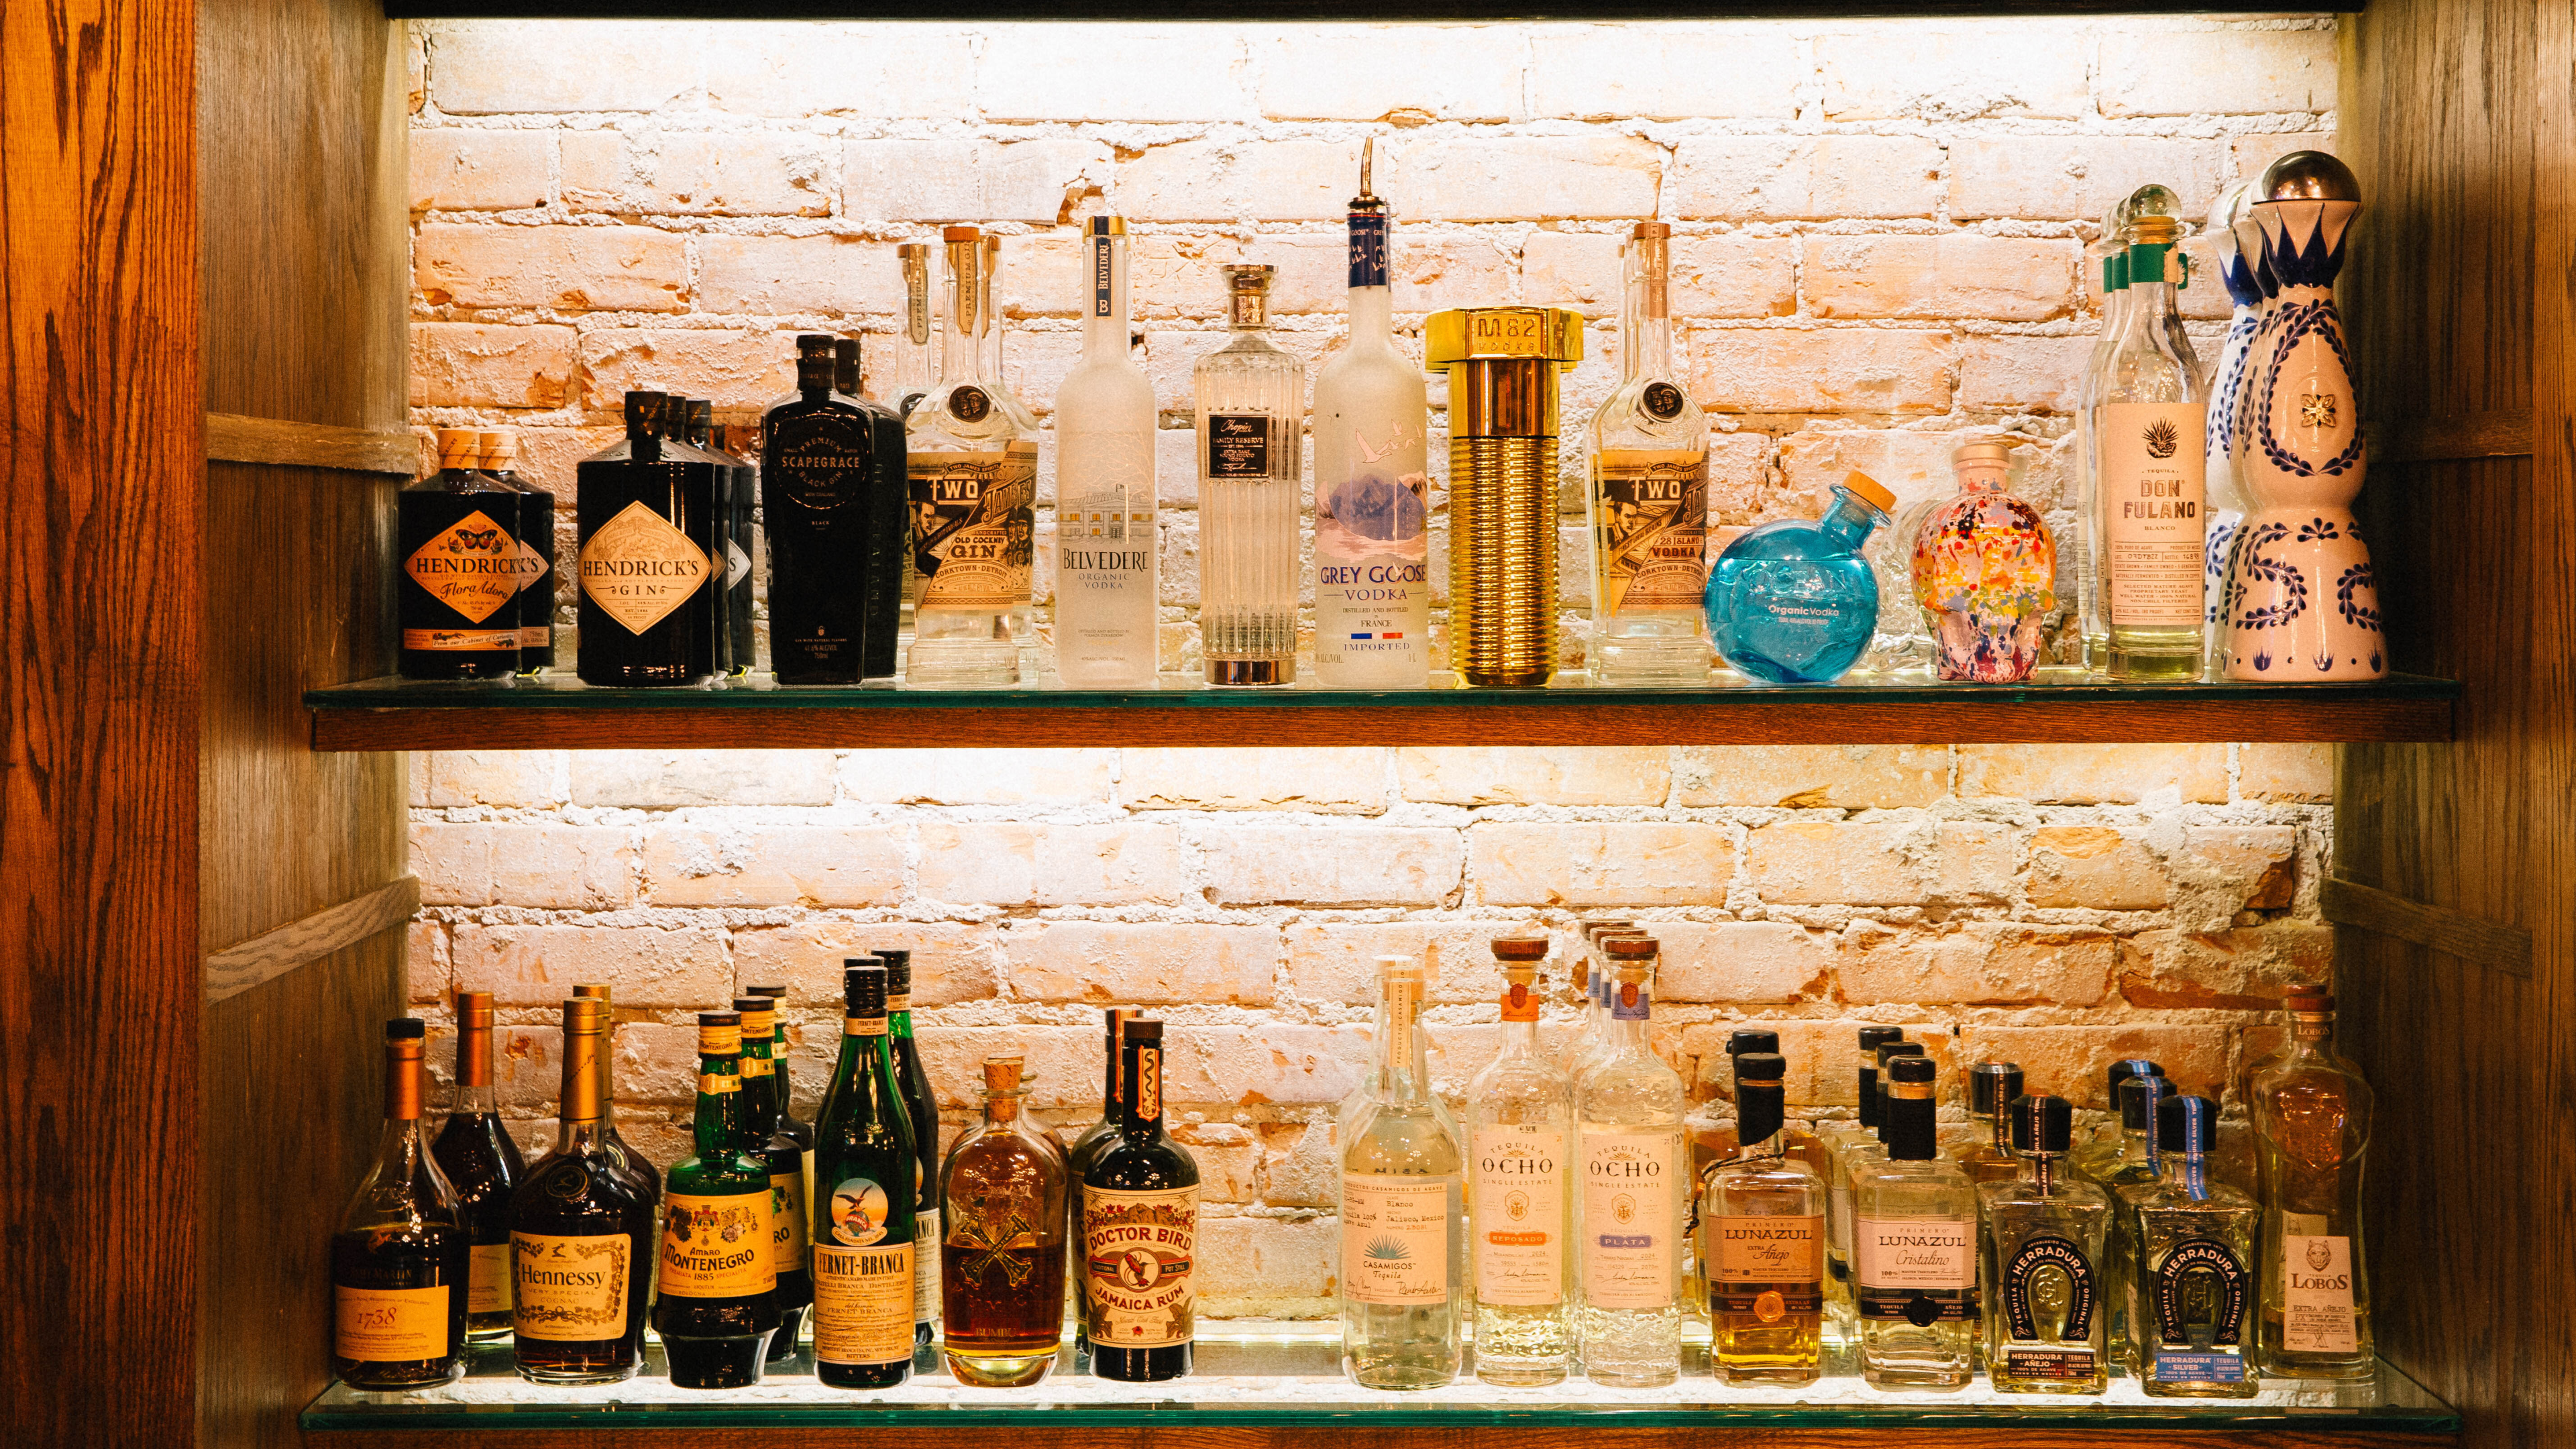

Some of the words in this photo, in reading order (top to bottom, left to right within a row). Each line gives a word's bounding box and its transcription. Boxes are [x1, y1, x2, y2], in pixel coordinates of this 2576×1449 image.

[1098, 244, 1110, 290] BELVEDERE
[1477, 318, 1536, 336] M82
[1221, 419, 1253, 435] Chopin
[799, 437, 843, 453] PREMIUM
[782, 456, 859, 468] SCAPEGRACE
[981, 464, 1000, 472] SPIRITS
[798, 471, 826, 488] BLACK
[828, 471, 843, 485] GIN
[927, 476, 979, 502] TWO
[1628, 476, 1680, 502] TWO
[2141, 480, 2180, 497] DON
[2124, 501, 2196, 519] FULANO
[950, 545, 997, 558] GIN
[1653, 547, 1696, 557] VODKA
[1063, 547, 1148, 572] BELVEDERE
[584, 559, 699, 576] HENDRICK'S
[936, 565, 977, 578] CORKTOWN
[981, 565, 1008, 578] DETROIT
[1320, 566, 1362, 586] GREY
[1368, 564, 1426, 584] GOOSE
[1637, 565, 1677, 578] CORKTOWN
[439, 582, 476, 599] Flora
[469, 581, 509, 599] Adora
[620, 585, 657, 595] GIN
[1345, 589, 1407, 601] VODKA
[1768, 604, 1809, 616] Organic
[1809, 607, 1839, 616] Vodka
[462, 636, 484, 645] Cabinet
[1344, 642, 1410, 651] IMPORTED
[740, 1024, 771, 1034] MONTENEGRO
[2298, 1024, 2330, 1036] LOBOS
[1490, 1142, 1544, 1156] TEQUILA
[1597, 1145, 1651, 1159] TEQUILA
[1482, 1157, 1553, 1174] OCHO
[1590, 1161, 1660, 1177] OCHO
[1344, 1182, 1368, 1190] PRODUCTOS
[846, 1216, 867, 1231] BRANCA
[835, 1230, 845, 1240] CASA
[1089, 1227, 1152, 1251] DOCTOR
[1157, 1228, 1191, 1251] BIRD
[1725, 1230, 1813, 1240] LUNAZUL
[1878, 1236, 1966, 1246] LUNAZUL
[690, 1247, 720, 1256] AMARO
[2027, 1240, 2060, 1248] ESTABLECIDO
[2179, 1242, 2212, 1250] ESTABLECIDO
[664, 1242, 755, 1272] MONTENEGRO
[1753, 1244, 1789, 1265] Añejo
[1896, 1249, 1949, 1265] Cristalino
[2012, 1246, 2086, 1278] HERRADURA
[818, 1252, 904, 1275] FERNET-BRANCA
[1175, 1264, 1185, 1272] STILL
[1363, 1260, 1413, 1270] CASAMIGOS
[2163, 1248, 2239, 1280] HERRADURA
[522, 1263, 606, 1289] Hennessy
[669, 1267, 692, 1279] PREMIATA
[694, 1273, 714, 1281] 1885
[1373, 1271, 1401, 1281] Tequila
[2291, 1273, 2348, 1290] LOBOS
[869, 1280, 908, 1289] DISTILLERIE
[1095, 1287, 1154, 1310] JAMAICA
[1157, 1285, 1184, 1307] RUM
[827, 1307, 856, 1315] FERNET
[2011, 1287, 2024, 1325] TEQUILA
[2077, 1287, 2090, 1326] ORIGINAL
[2163, 1289, 2175, 1327] TEQUILA
[2228, 1290, 2241, 1328] ORIGINAL
[2322, 1304, 2347, 1313] AÑEJO
[357, 1307, 397, 1330] 1738
[2024, 1359, 2051, 1367] AÑEJO
